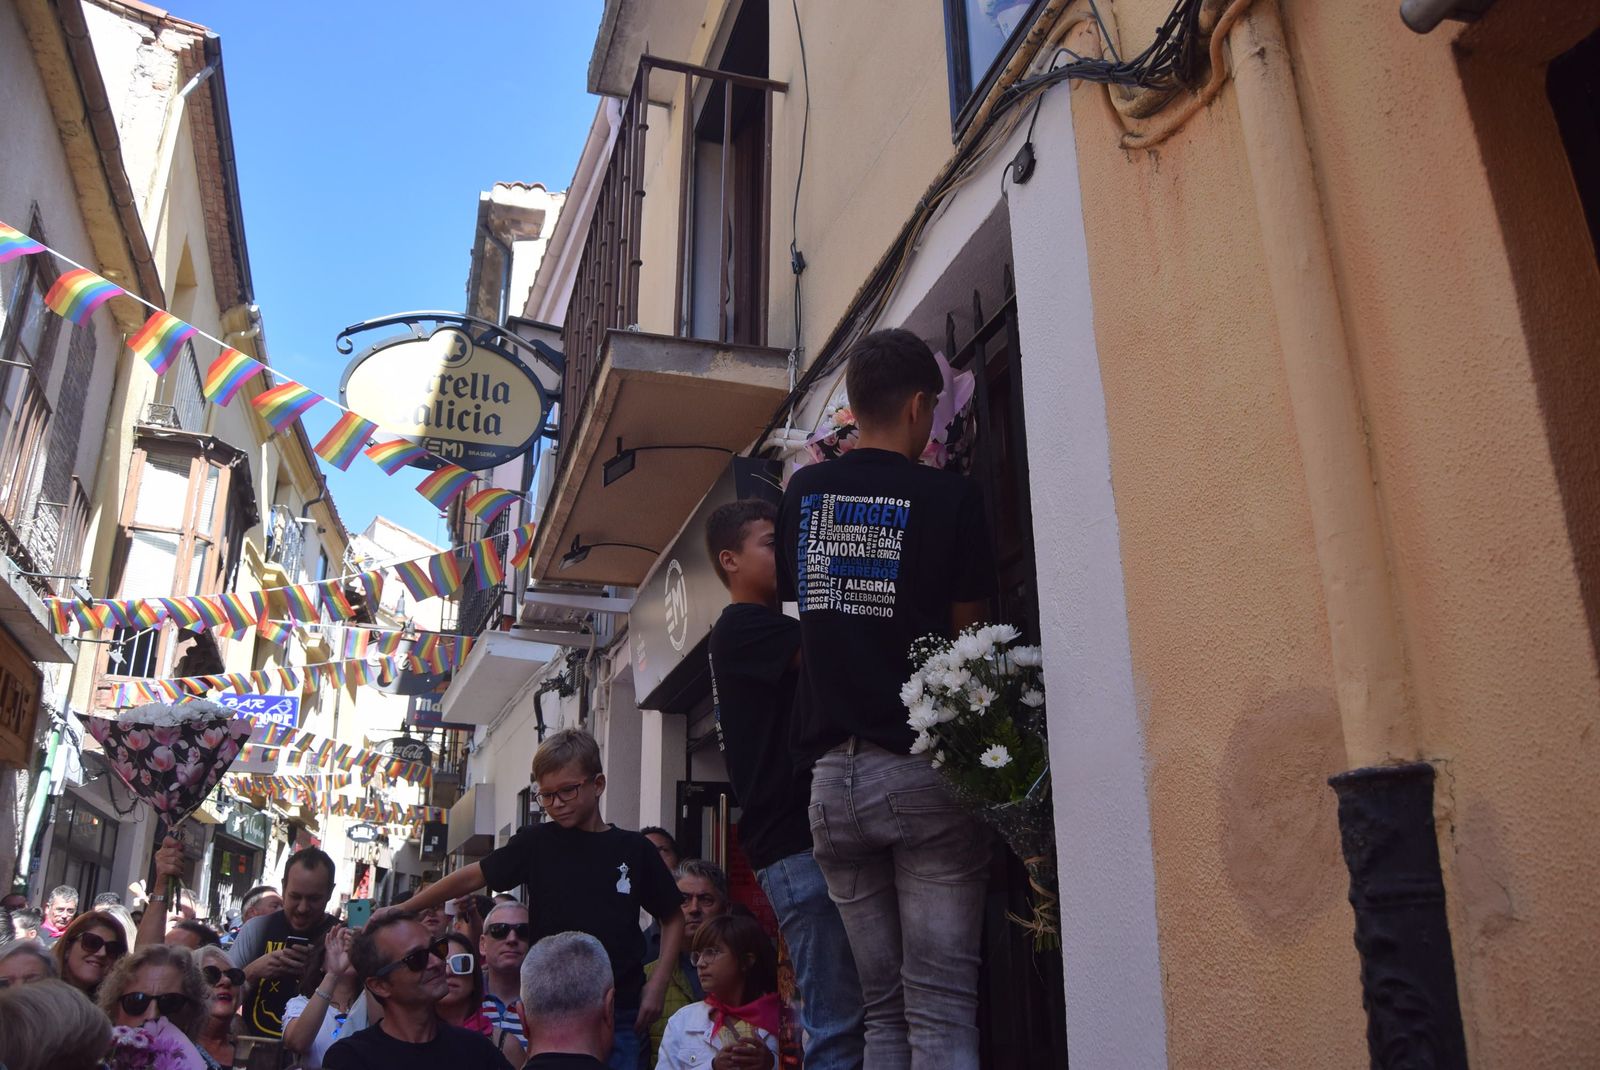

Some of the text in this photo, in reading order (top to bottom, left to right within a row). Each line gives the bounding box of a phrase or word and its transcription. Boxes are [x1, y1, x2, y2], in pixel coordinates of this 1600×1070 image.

[412, 398, 502, 436] alicia
[867, 496, 911, 508] AMIGOS
[819, 493, 829, 540] SOLEMNIDAD
[833, 501, 910, 529] VIRGEN
[809, 510, 820, 539] FIESTA
[832, 533, 867, 542] VERBENA
[879, 526, 905, 541] ALE
[797, 495, 812, 612] HOMENAJE
[807, 539, 866, 558] ZAMORA
[876, 549, 900, 561] CERVEZA
[807, 554, 831, 567] TAPEO
[806, 564, 829, 574] BARES
[829, 565, 898, 580] HERREROS
[807, 588, 830, 596] PINCHOS
[845, 578, 896, 594] ALEGRÍA
[807, 596, 830, 604] PROCE
[844, 591, 896, 605] CELEBRACIÓN
[807, 602, 829, 611] SIONAR
[843, 603, 894, 618] REGOCIJO
[224, 697, 266, 710] BAR
